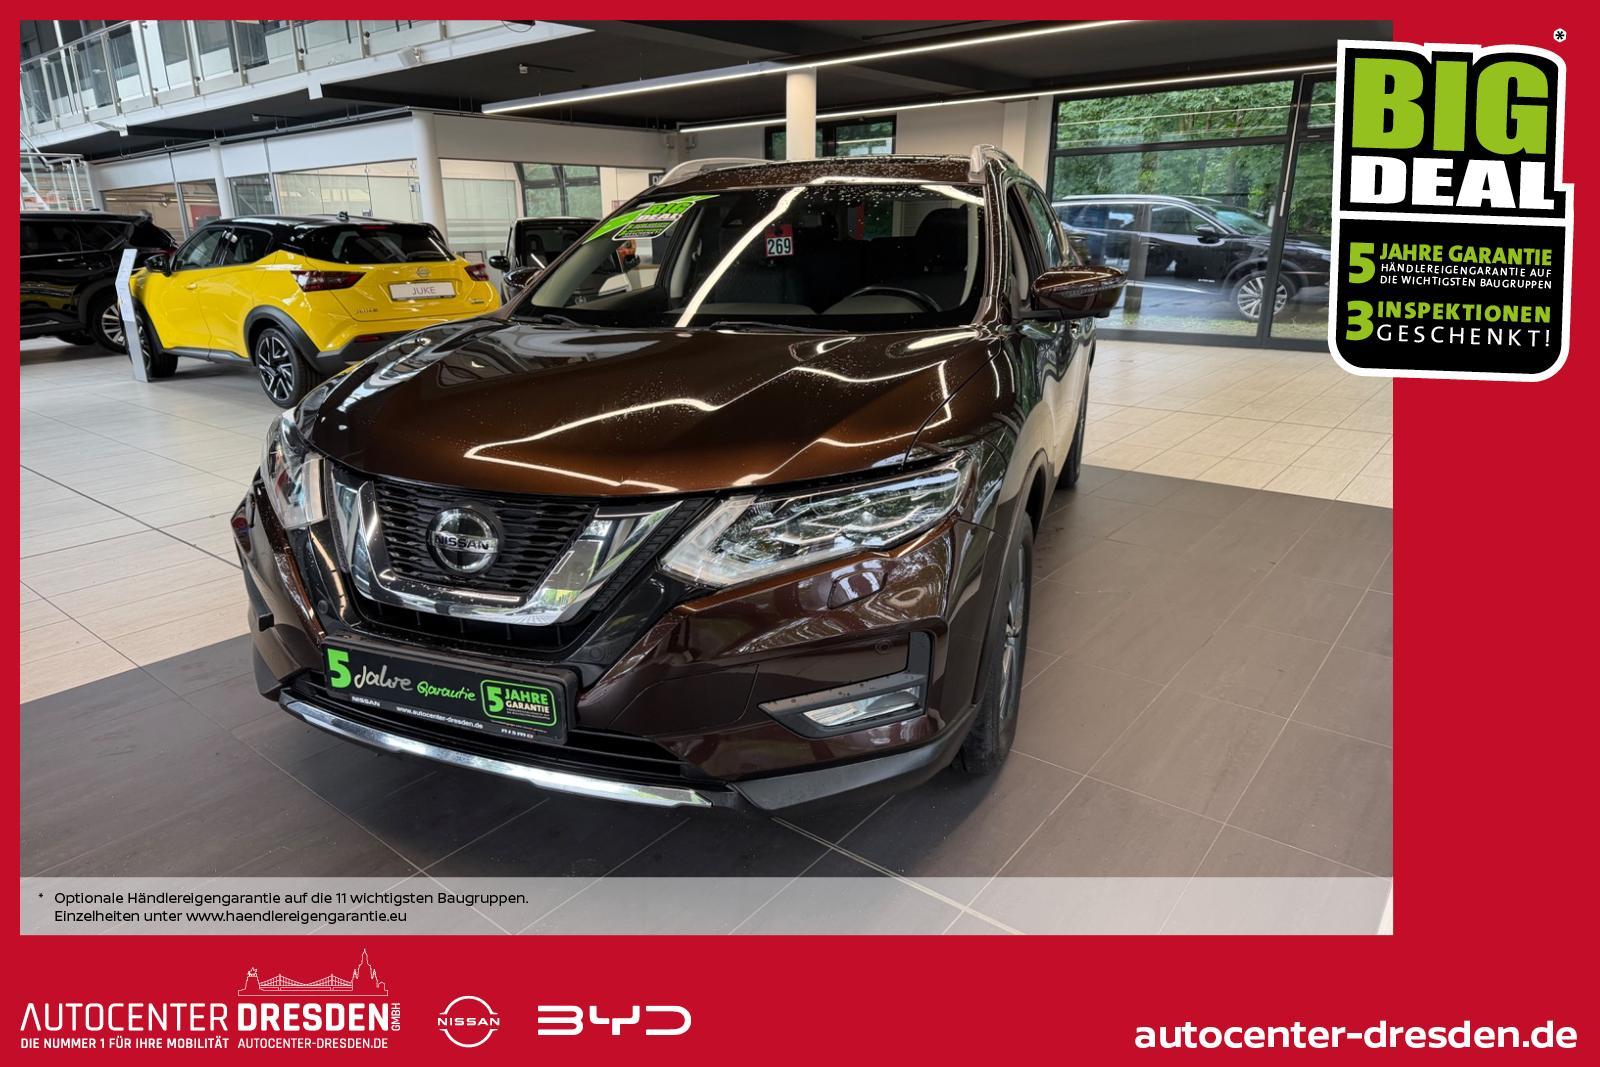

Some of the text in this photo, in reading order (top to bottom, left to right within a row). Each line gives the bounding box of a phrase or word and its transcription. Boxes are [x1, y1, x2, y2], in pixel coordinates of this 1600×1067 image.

[767, 238, 791, 255] 269
[412, 286, 437, 295] JUKE
[434, 535, 489, 550] NISSAN
[327, 648, 352, 689] 5
[354, 665, 413, 691] Jahre
[486, 685, 549, 713] 5 JAHRE
[505, 700, 550, 714] GARANTIE
